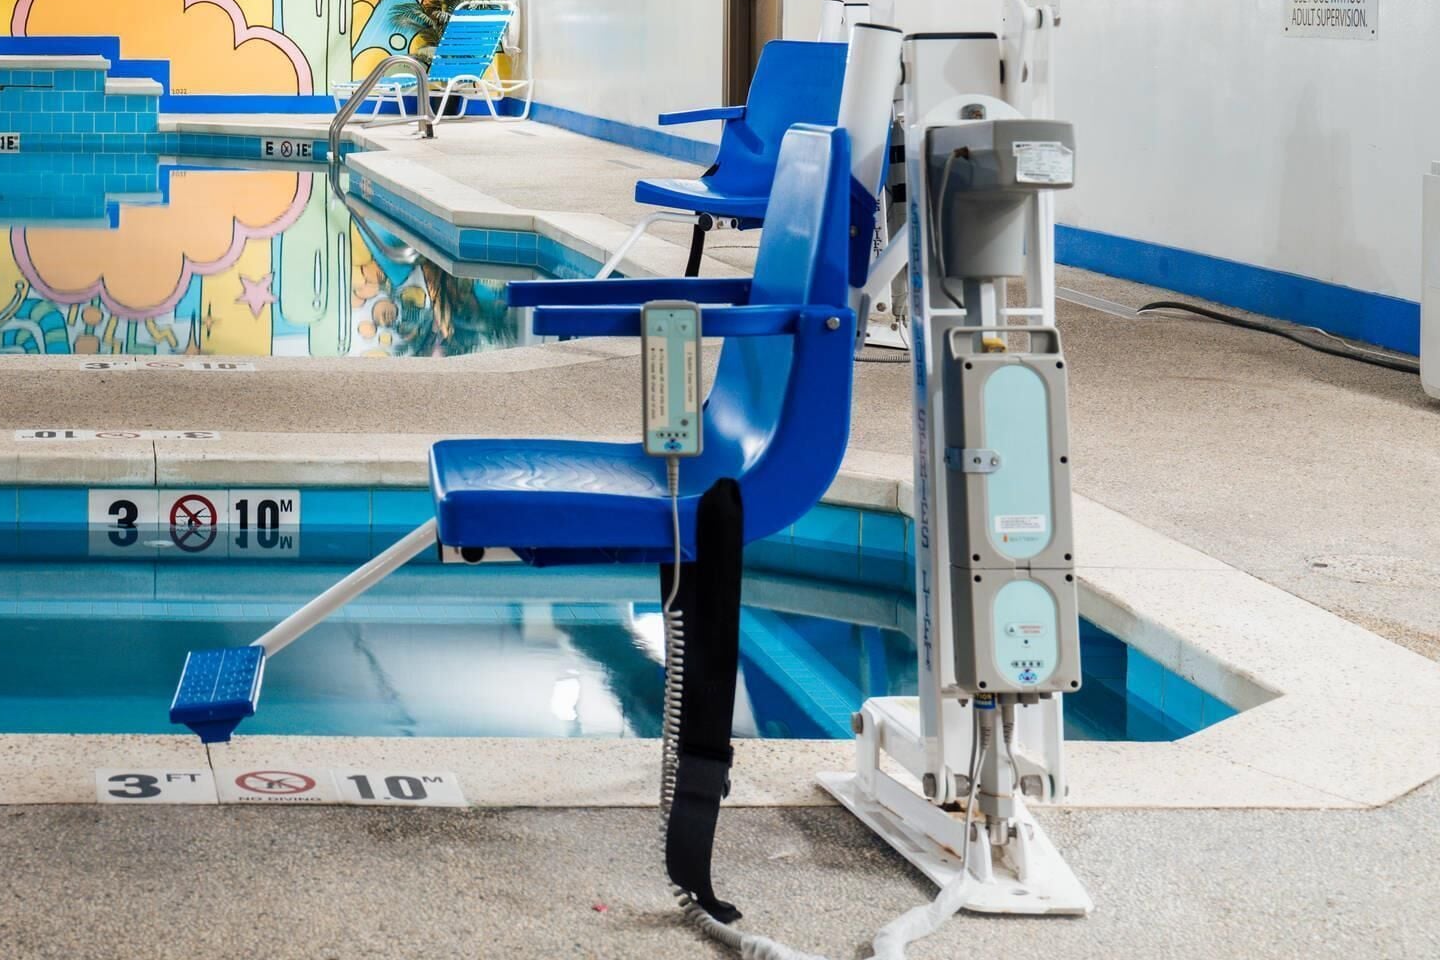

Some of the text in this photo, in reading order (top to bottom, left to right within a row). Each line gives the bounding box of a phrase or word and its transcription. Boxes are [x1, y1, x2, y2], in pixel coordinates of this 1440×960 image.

[1292, 8, 1368, 27] ADULT SUPERVISION.
[918, 408, 930, 549] SERIES
[108, 499, 138, 529] 3
